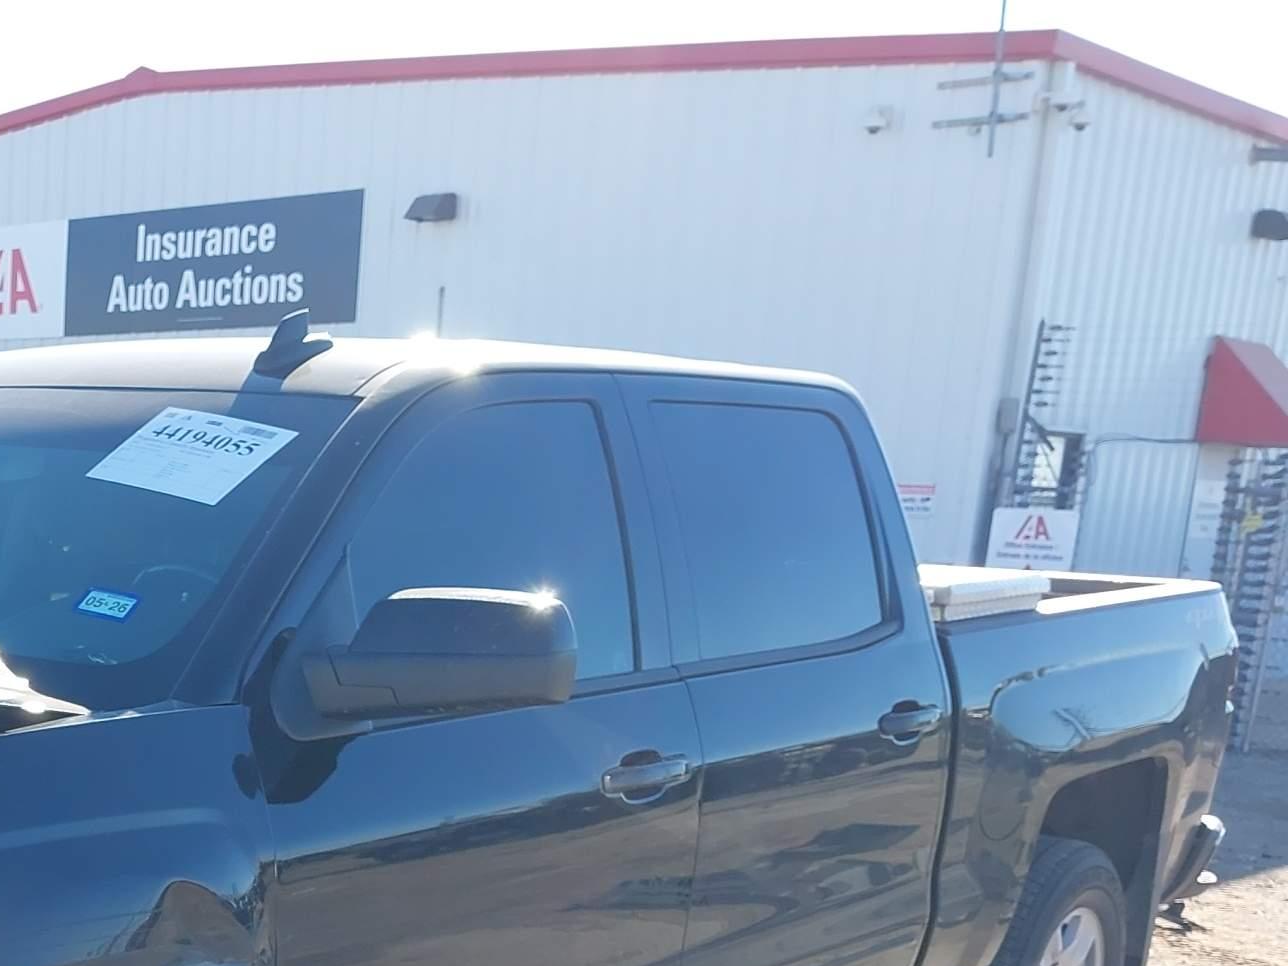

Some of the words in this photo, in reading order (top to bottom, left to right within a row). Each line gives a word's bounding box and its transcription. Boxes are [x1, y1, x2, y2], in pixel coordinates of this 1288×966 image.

[136, 222, 276, 262] Insurance
[106, 274, 169, 313] Auto
[175, 264, 304, 309] Auctions
[151, 424, 261, 456] 44194055
